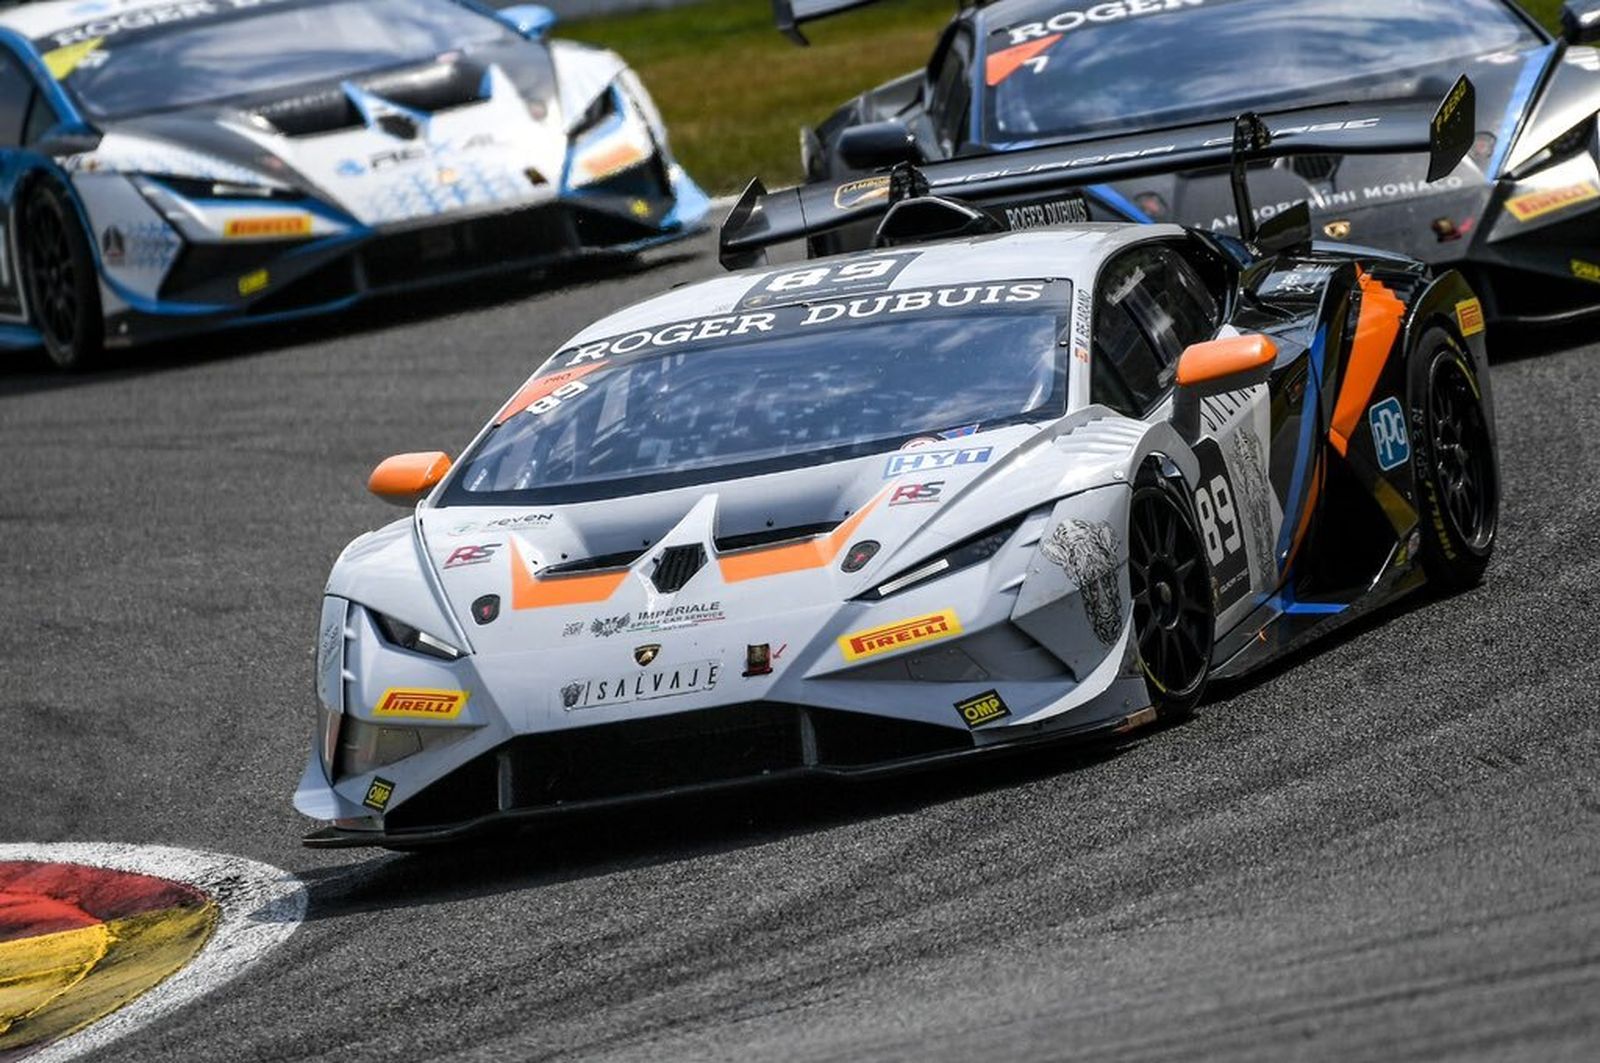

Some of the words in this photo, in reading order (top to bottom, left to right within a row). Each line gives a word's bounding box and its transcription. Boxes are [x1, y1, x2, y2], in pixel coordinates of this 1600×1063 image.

[1005, 204, 1045, 231] ROGER
[1044, 198, 1087, 224] DUBUIS
[765, 258, 898, 292] 89
[565, 312, 777, 367] ROGER
[799, 284, 1045, 326] DUBUIS
[525, 381, 589, 415] 89
[1373, 409, 1406, 461] PPG
[890, 447, 993, 474] HYT
[890, 481, 946, 502] RS
[1195, 474, 1241, 567] 89
[445, 543, 502, 565] RS
[638, 601, 720, 620] IMPERIALE
[850, 615, 949, 654] PIRELLI
[597, 664, 719, 700] SALVAJE
[381, 692, 459, 713] PIRELLI
[963, 698, 1000, 720] OMP
[368, 785, 390, 804] OMP
